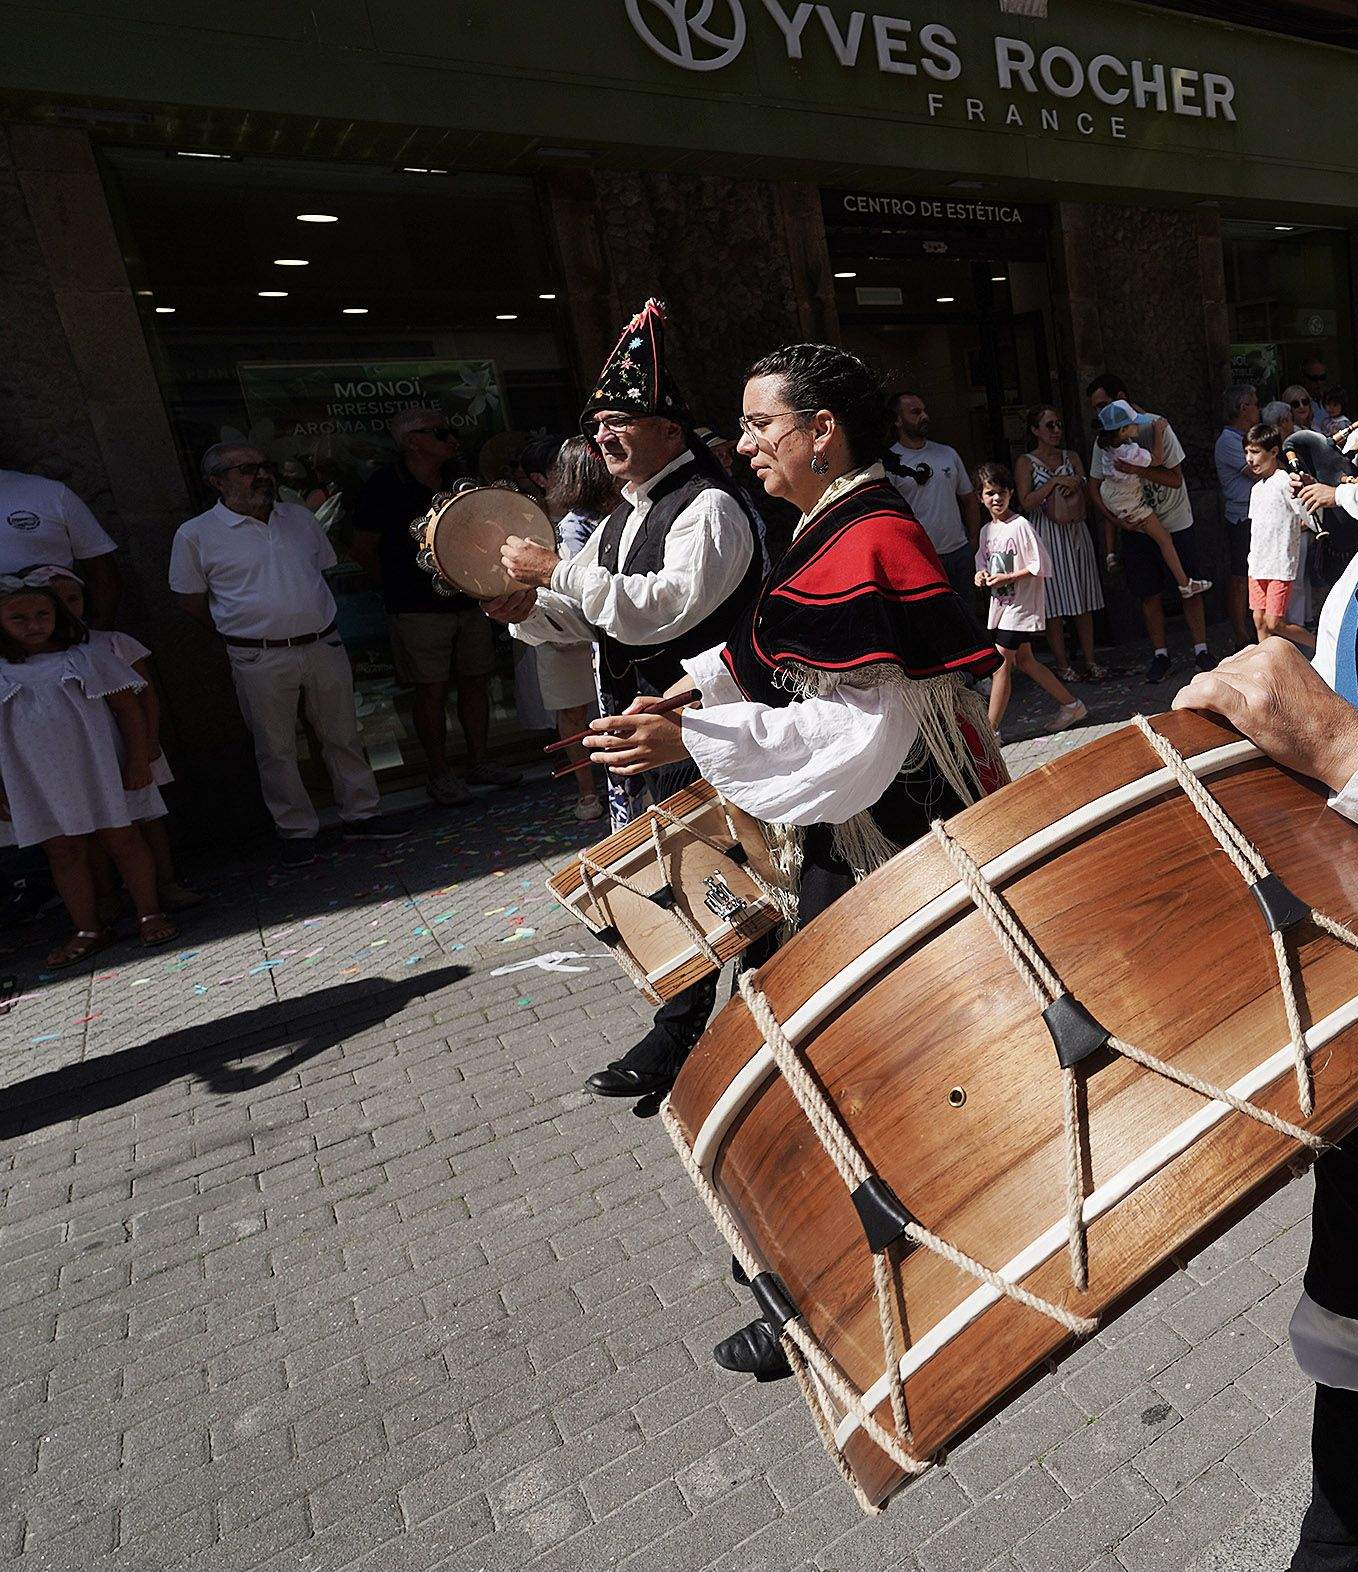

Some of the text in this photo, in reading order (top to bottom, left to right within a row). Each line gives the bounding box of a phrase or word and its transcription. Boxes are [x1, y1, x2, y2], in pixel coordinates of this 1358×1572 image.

[763, 0, 1237, 122] YVES ROCHER
[928, 93, 1127, 138] FRANCE
[843, 195, 1022, 223] CENTRO DE ESTÉTICA
[293, 419, 367, 436] AROMA
